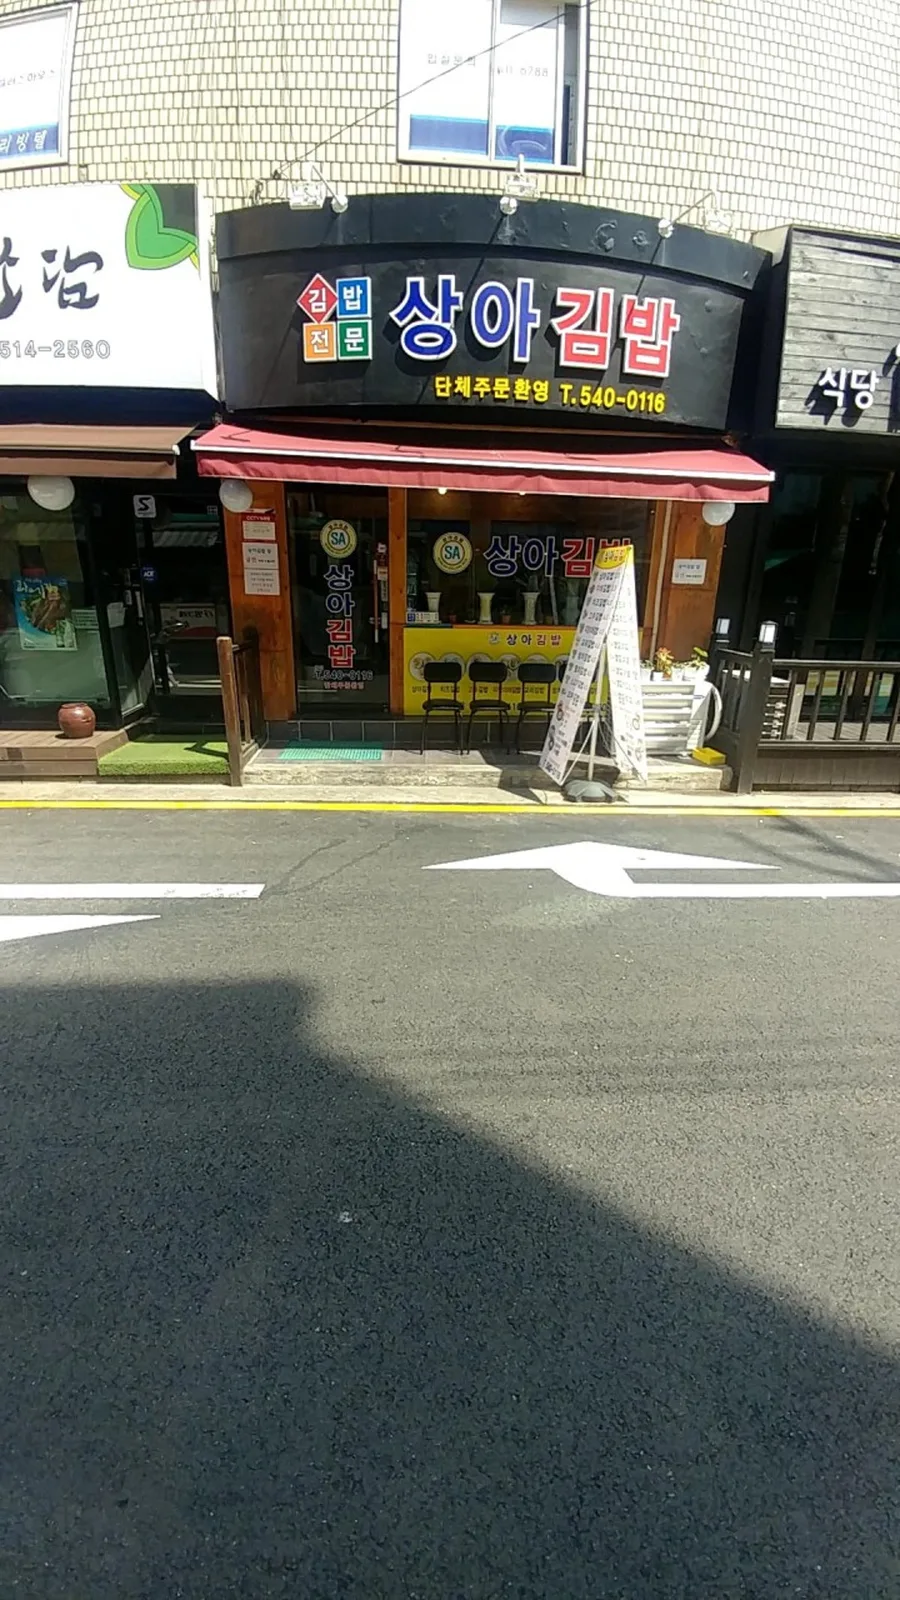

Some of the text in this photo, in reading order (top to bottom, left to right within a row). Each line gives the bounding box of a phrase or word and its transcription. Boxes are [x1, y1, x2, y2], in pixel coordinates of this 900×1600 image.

[306, 284, 365, 314] 김밥
[307, 324, 367, 355] 전문
[389, 274, 680, 378] 상아김밥
[559, 383, 666, 413] T.540-0116
[818, 366, 880, 410] 식당
[331, 532, 346, 545] SA
[444, 546, 460, 559] SA
[324, 565, 357, 668] 상아김밥
[506, 634, 561, 646] 상아김밥
